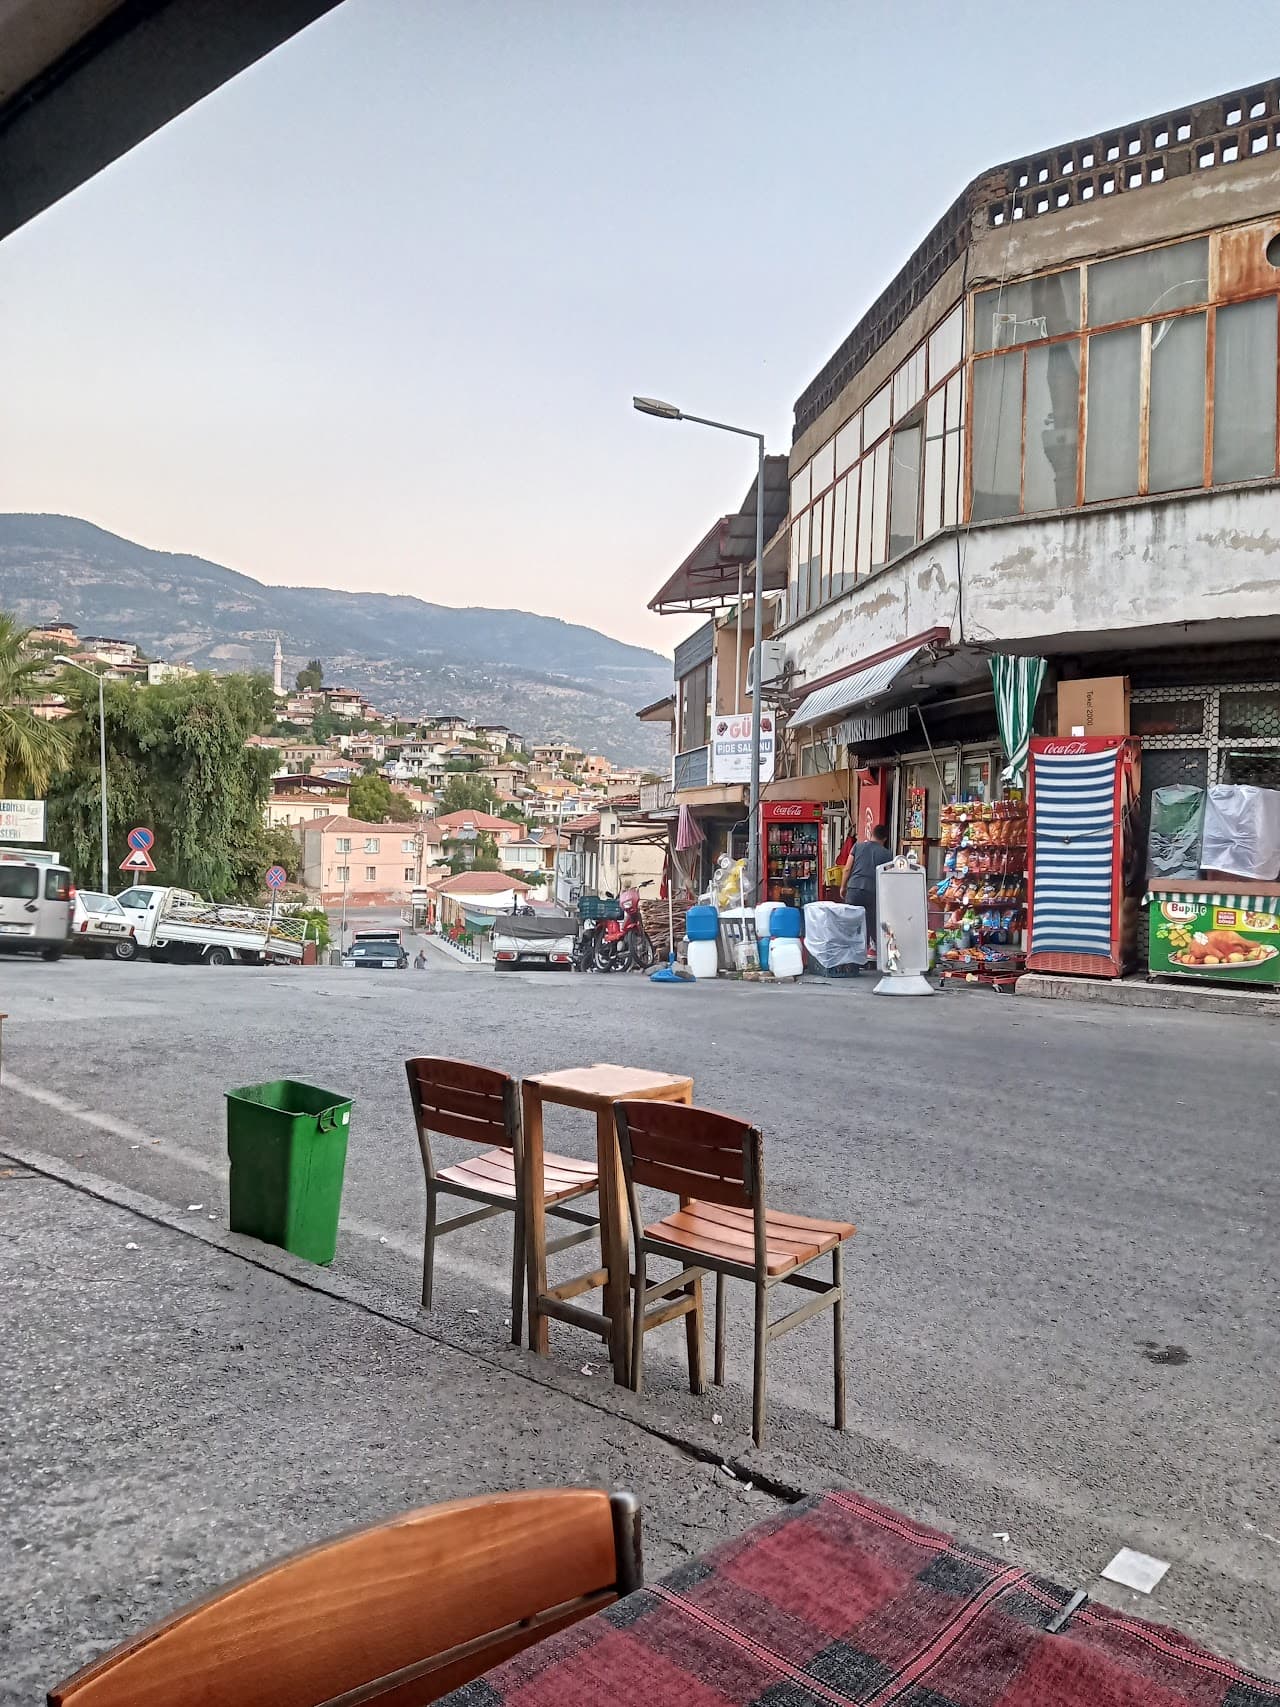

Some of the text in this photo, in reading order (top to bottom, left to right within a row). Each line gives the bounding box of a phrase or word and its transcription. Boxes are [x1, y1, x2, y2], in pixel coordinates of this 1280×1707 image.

[1086, 709, 1094, 726] 2000
[730, 716, 752, 738] GÜ
[737, 741, 771, 754] SALNU
